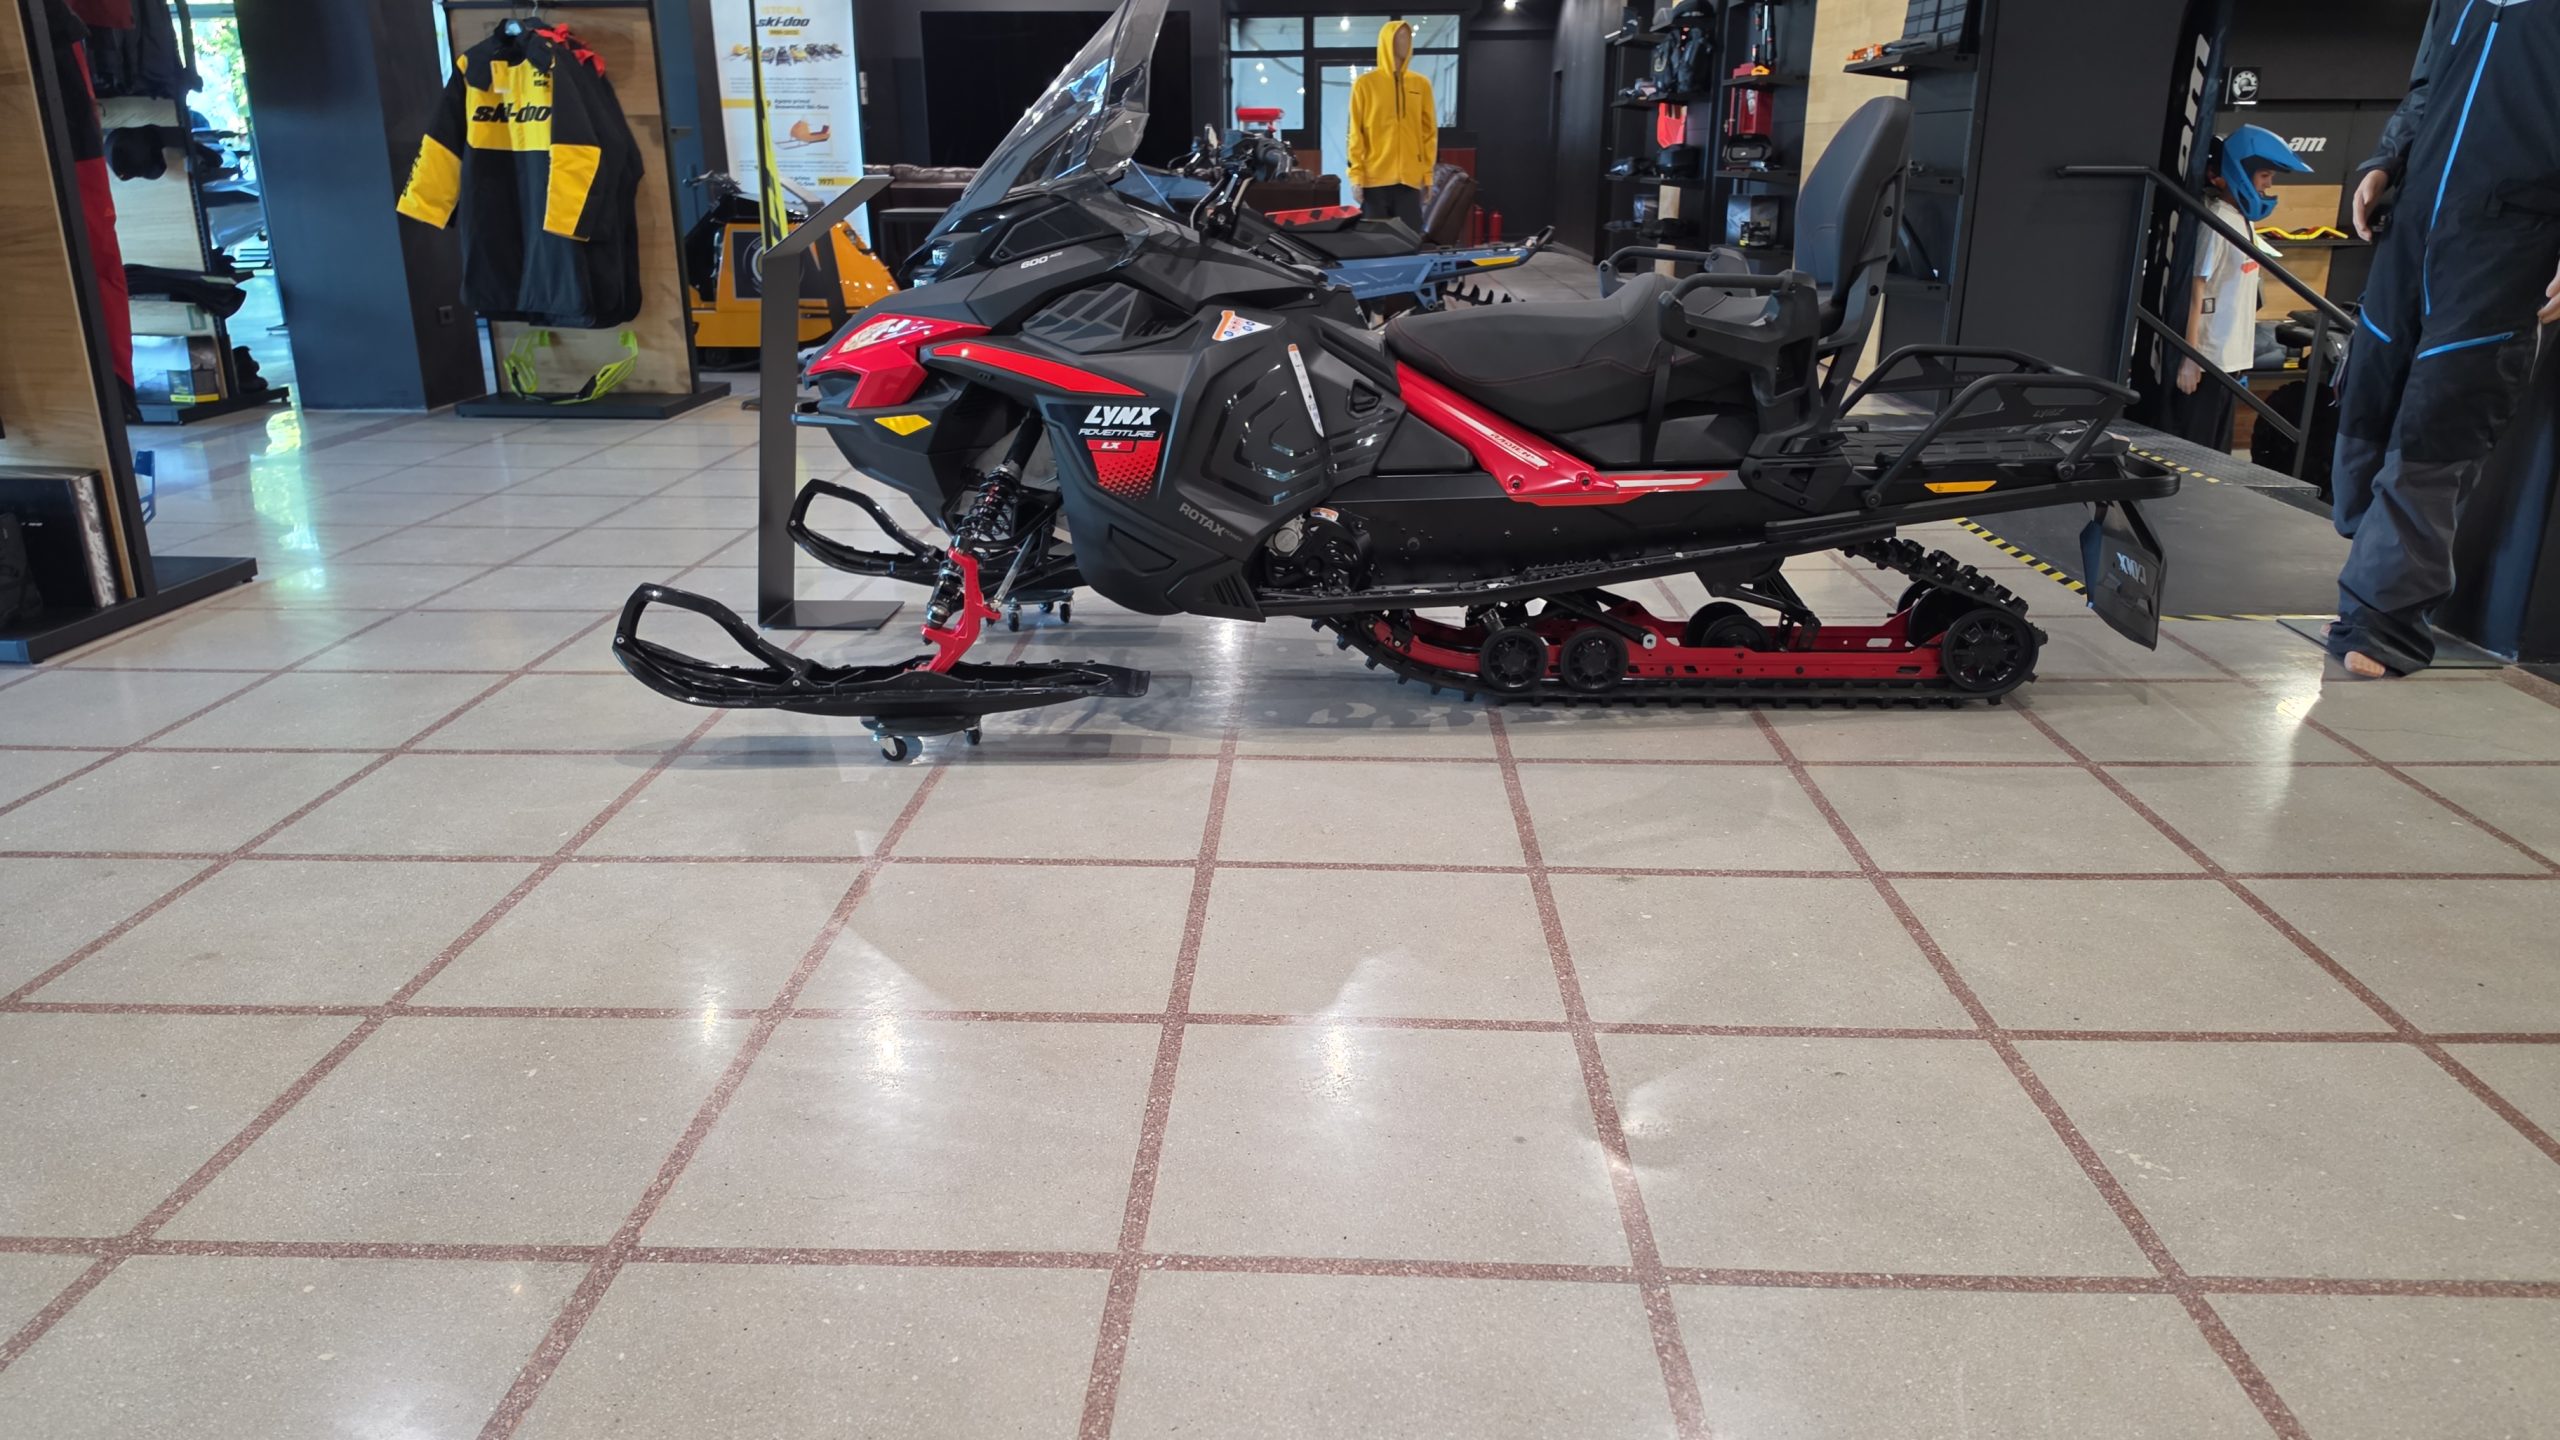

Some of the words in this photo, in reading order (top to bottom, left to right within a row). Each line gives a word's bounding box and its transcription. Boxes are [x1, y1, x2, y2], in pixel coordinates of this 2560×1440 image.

[756, 17, 810, 27] ski-doo
[1021, 255, 1049, 269] 600
[1084, 405, 1160, 426] LYNX
[1079, 428, 1156, 437] ADVENTURE
[1179, 502, 1225, 536] ROTAX
